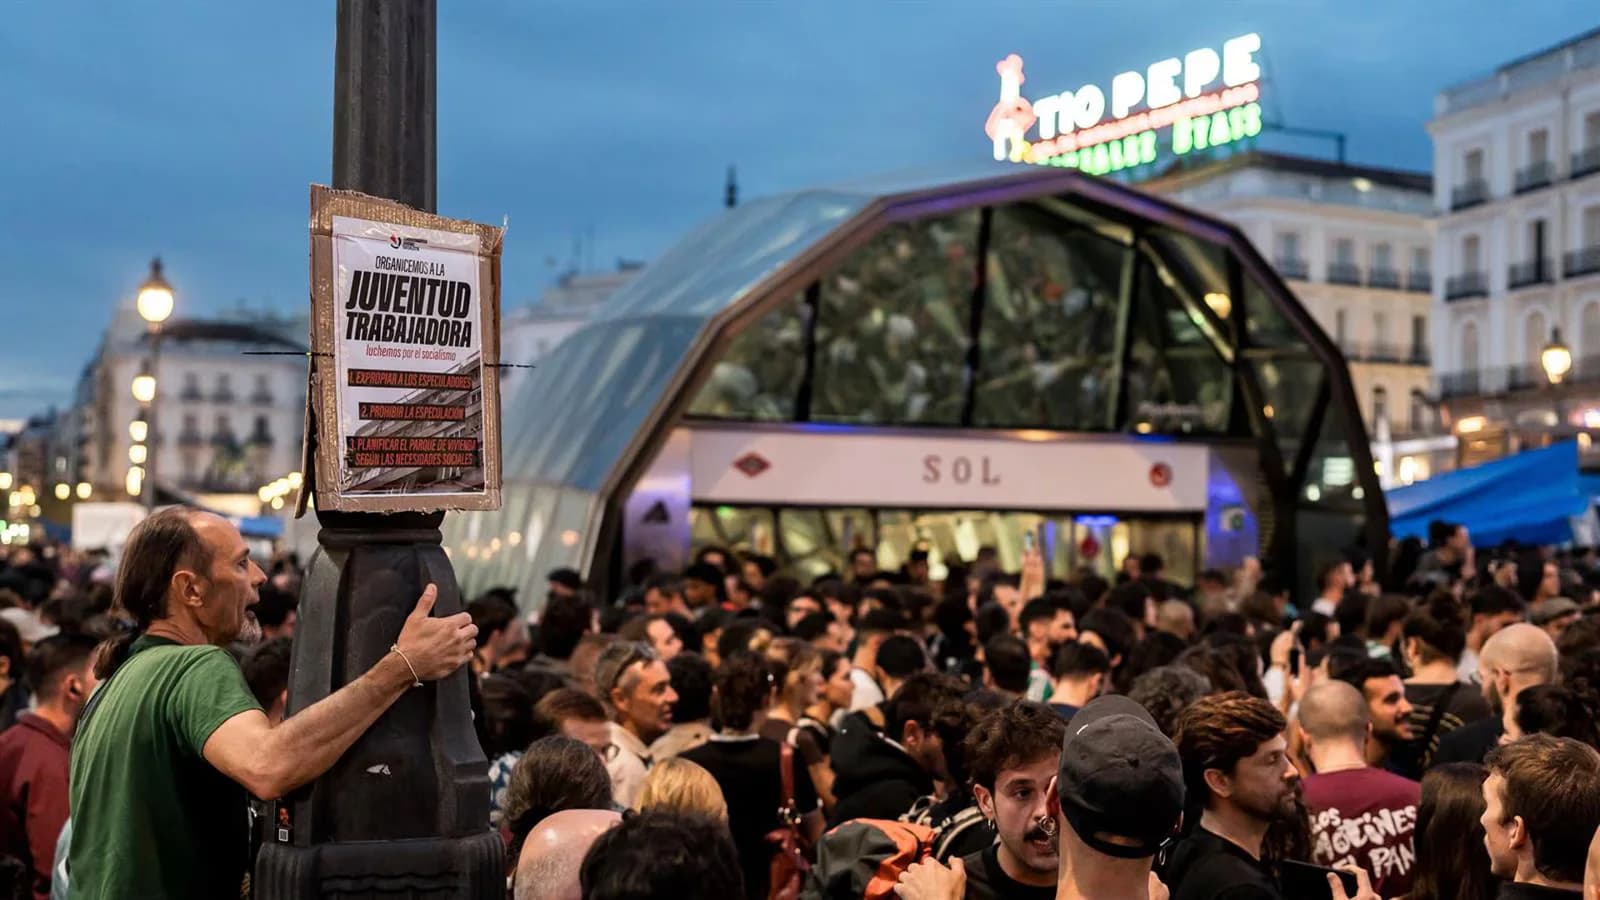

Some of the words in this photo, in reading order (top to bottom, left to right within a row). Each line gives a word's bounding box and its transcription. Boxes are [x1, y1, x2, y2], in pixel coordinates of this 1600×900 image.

[1033, 84, 1105, 139] TIO
[1112, 32, 1261, 118] PEPE
[375, 255, 429, 275] ORGANICEMOS
[429, 262, 435, 275] A
[436, 263, 445, 277] LA
[345, 270, 471, 319] JUVENTUD
[345, 311, 472, 348] TRABAJADORA
[366, 344, 401, 358] luchemos
[402, 348, 414, 360] por
[414, 348, 421, 359] el
[422, 348, 456, 361] socialismo
[404, 373, 417, 386] LOS
[404, 407, 413, 418] LA
[357, 438, 399, 450] PLANIFICAR
[400, 439, 408, 450] EL
[409, 439, 436, 451] PARQUE
[437, 439, 447, 451] DE
[380, 453, 395, 466] LAS
[395, 453, 441, 466] NECESIDADES
[441, 454, 473, 466] SOCIALES
[922, 454, 1002, 486] SOL
[1308, 807, 1341, 835] LOS
[1368, 835, 1417, 879] PAN
